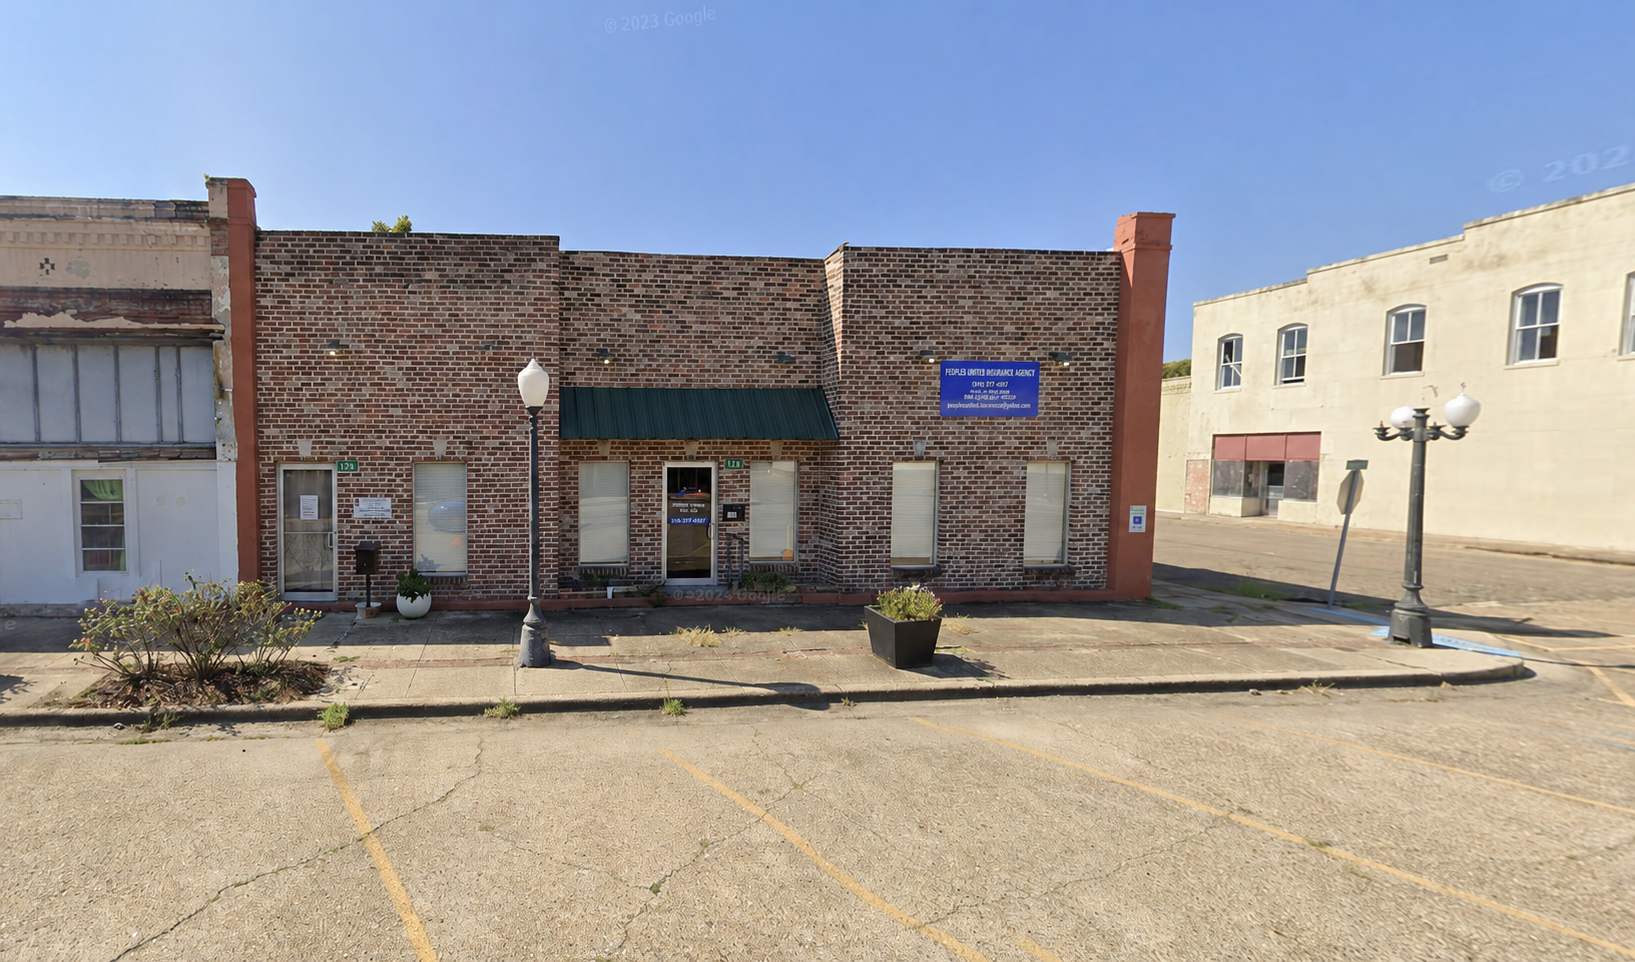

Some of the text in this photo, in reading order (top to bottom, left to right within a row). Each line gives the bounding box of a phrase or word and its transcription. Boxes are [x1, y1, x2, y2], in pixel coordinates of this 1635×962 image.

[945, 368, 966, 376] PEOPLES
[986, 368, 1014, 377] INSURANCE
[1015, 369, 1036, 377] AGENCY
